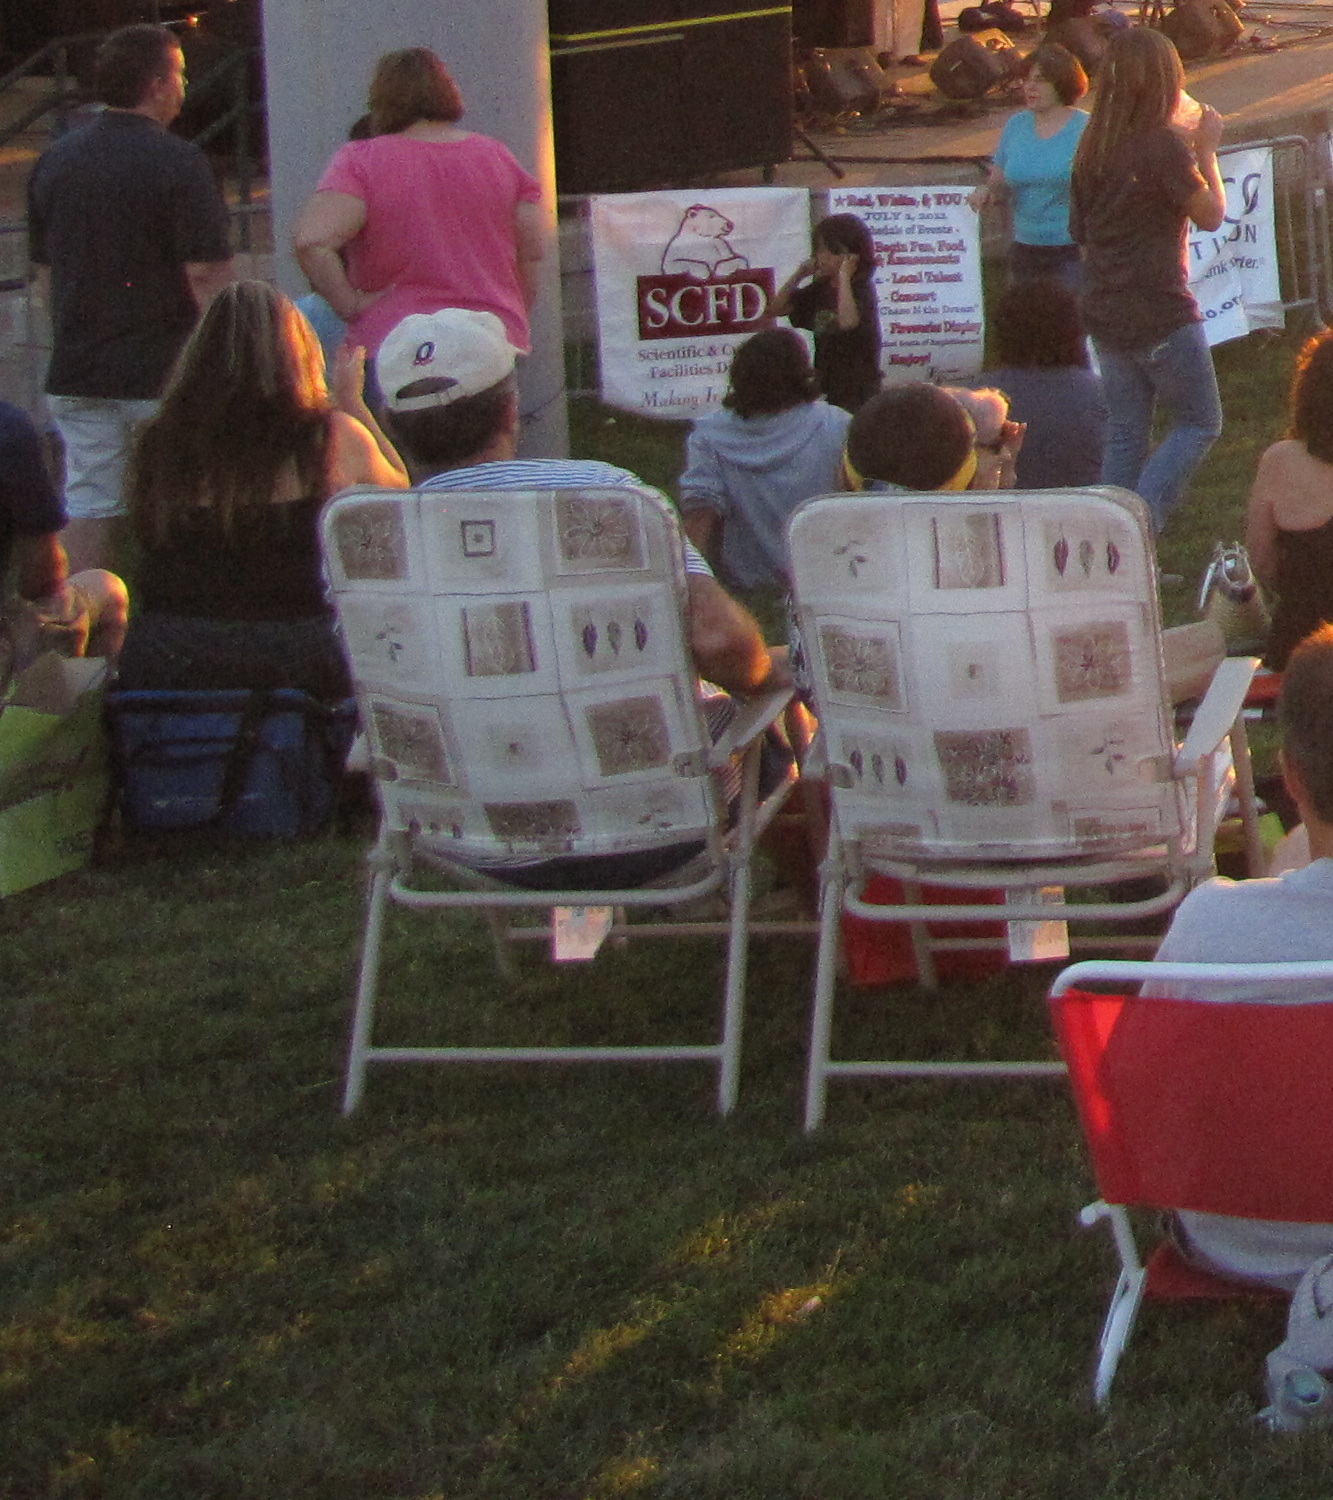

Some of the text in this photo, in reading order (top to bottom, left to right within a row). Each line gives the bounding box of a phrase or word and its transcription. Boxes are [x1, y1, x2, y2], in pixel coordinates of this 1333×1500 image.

[877, 193, 919, 208] White,
[932, 192, 962, 206] YOU
[865, 212, 901, 221] JULY
[646, 282, 768, 329] SCFD
[638, 345, 705, 362] Scientific
[707, 346, 717, 357] &
[648, 361, 714, 379] Facilities
